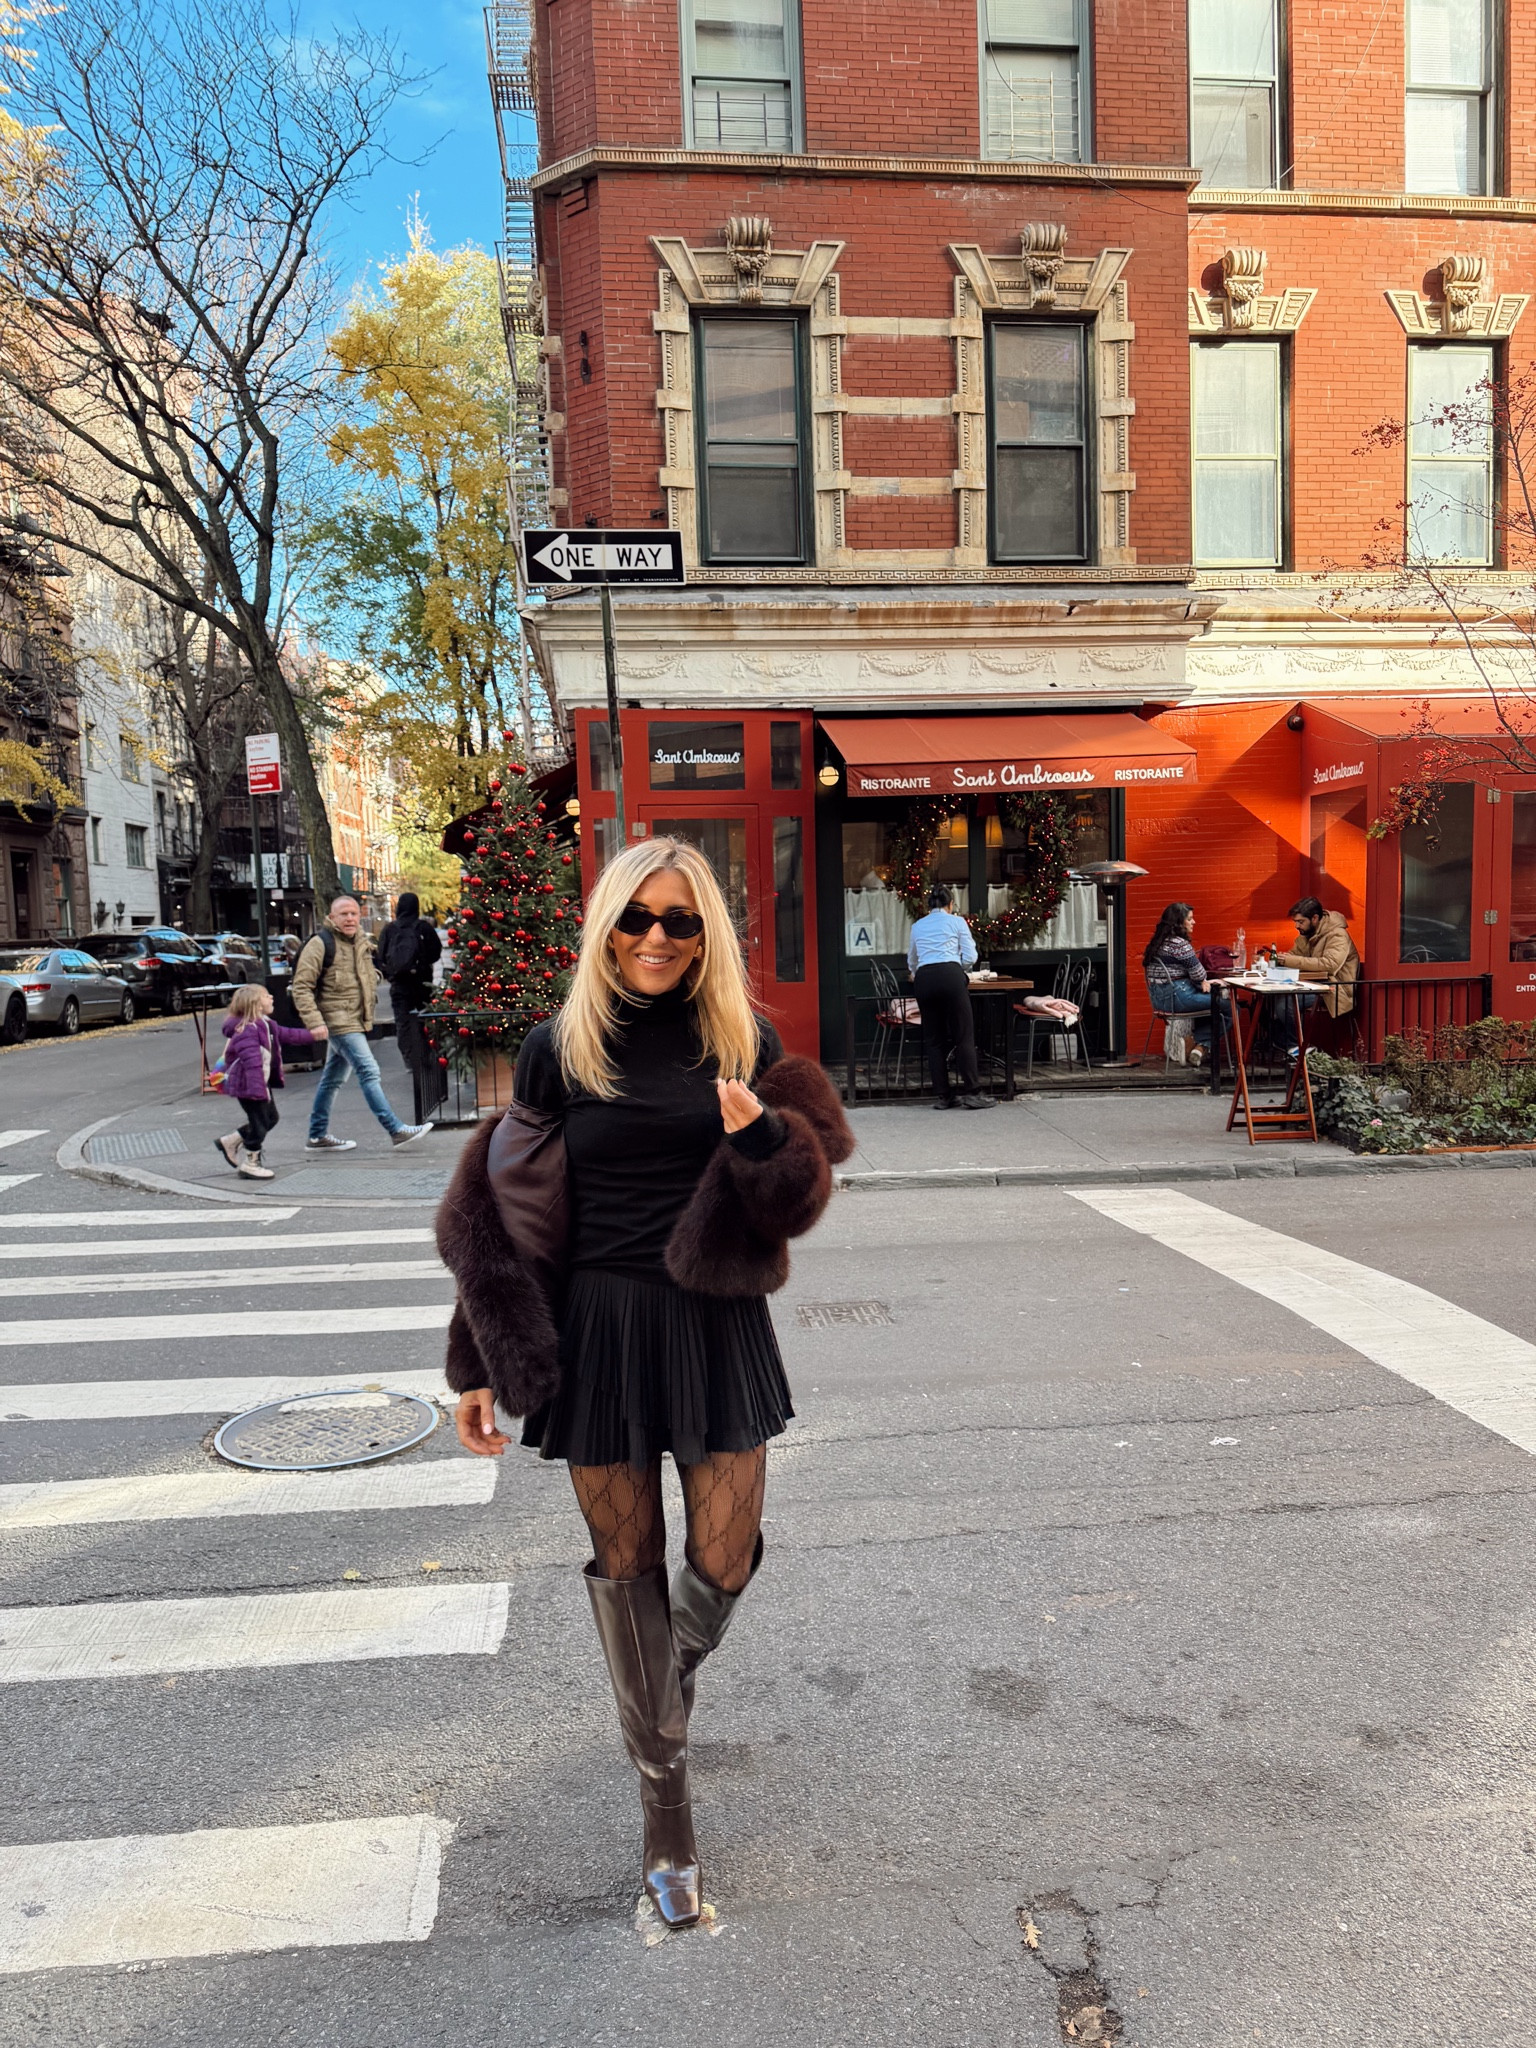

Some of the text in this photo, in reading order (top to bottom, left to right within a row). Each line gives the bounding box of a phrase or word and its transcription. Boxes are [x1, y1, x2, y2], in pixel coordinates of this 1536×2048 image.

[551, 547, 662, 567] ONE WAY
[654, 748, 682, 764] Sant
[250, 773, 267, 781] Anytime
[256, 765, 276, 773] STANDING
[952, 764, 1095, 787] Sant Ambroeus
[1114, 767, 1184, 781] RISTORANTE
[1313, 768, 1329, 785] Sant
[861, 777, 931, 790] RISTORANTE
[855, 927, 872, 946] A
